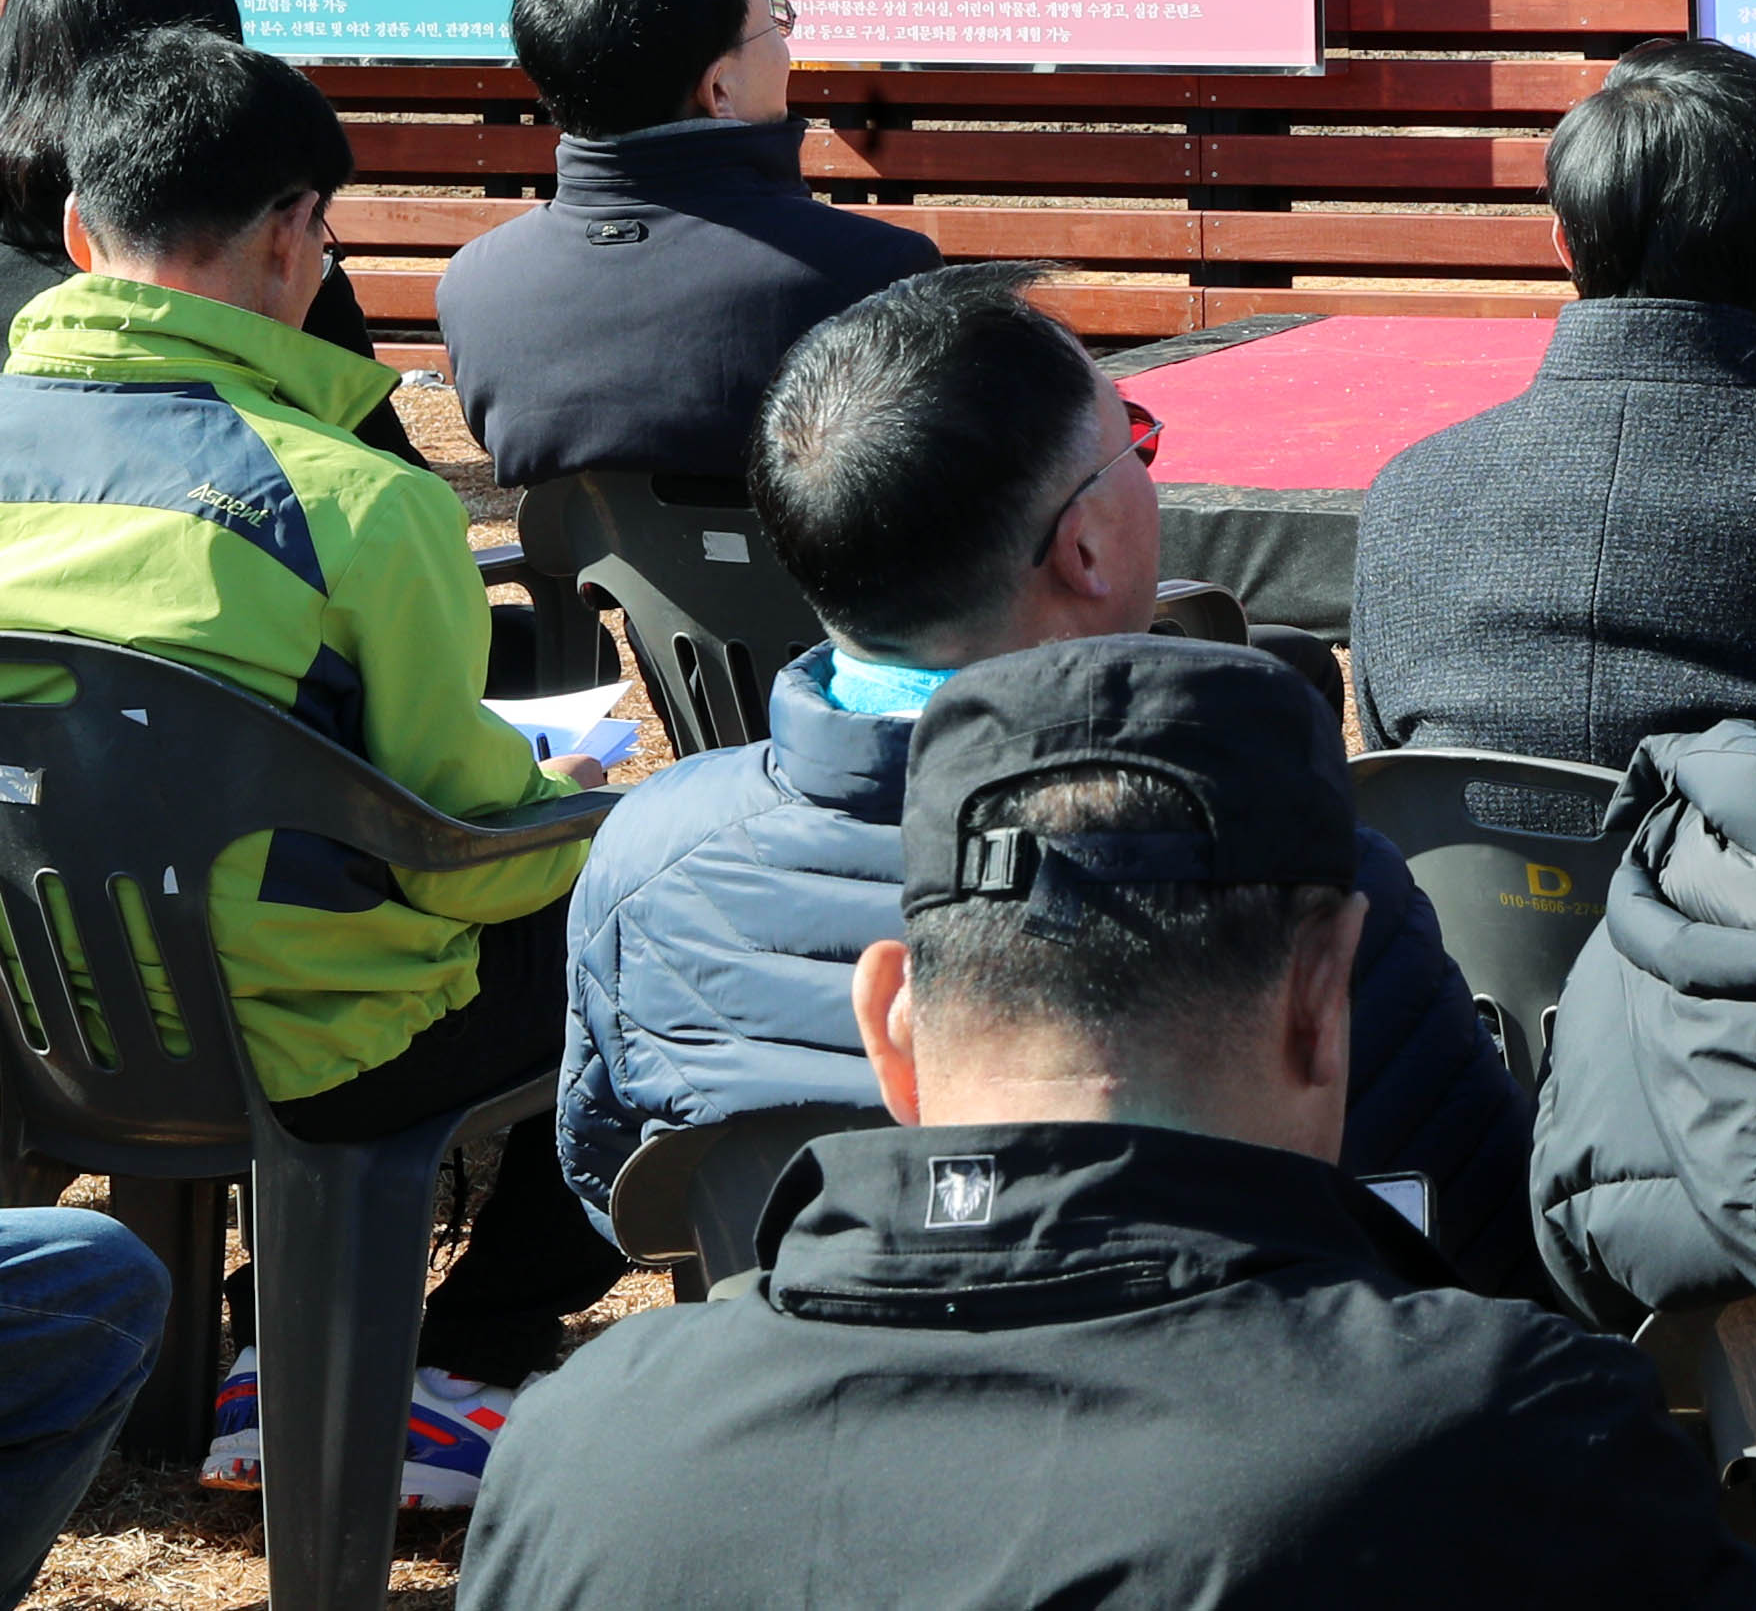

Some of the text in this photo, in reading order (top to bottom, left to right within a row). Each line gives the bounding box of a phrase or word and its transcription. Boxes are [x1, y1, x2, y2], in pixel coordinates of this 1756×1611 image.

[790, 0, 878, 17] 립나주박물관은
[187, 481, 269, 528] Ascent
[1525, 862, 1573, 897] D
